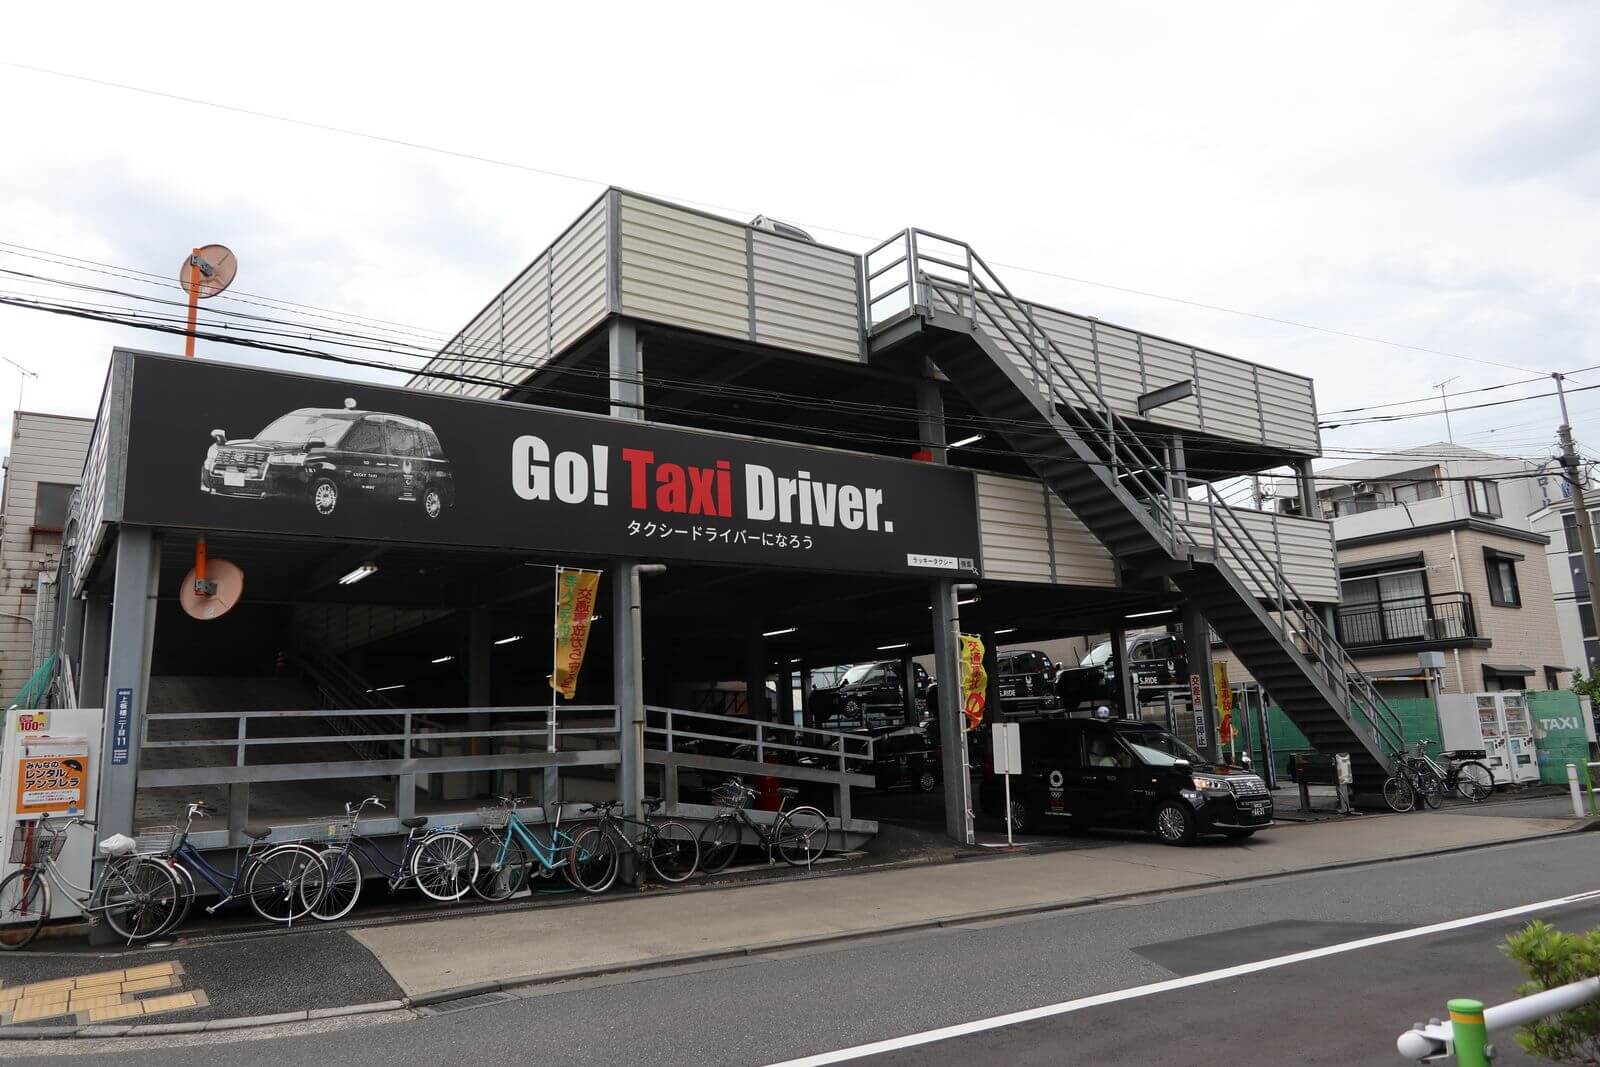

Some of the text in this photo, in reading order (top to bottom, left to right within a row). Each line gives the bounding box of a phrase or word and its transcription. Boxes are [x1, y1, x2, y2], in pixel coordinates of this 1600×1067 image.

[511, 434, 894, 533] Go! Taxi Driver.
[627, 519, 813, 549] タクシードライバーになろう
[1540, 716, 1579, 730] TAXI
[25, 761, 60, 769] みんなの
[25, 768, 67, 779] レンタル
